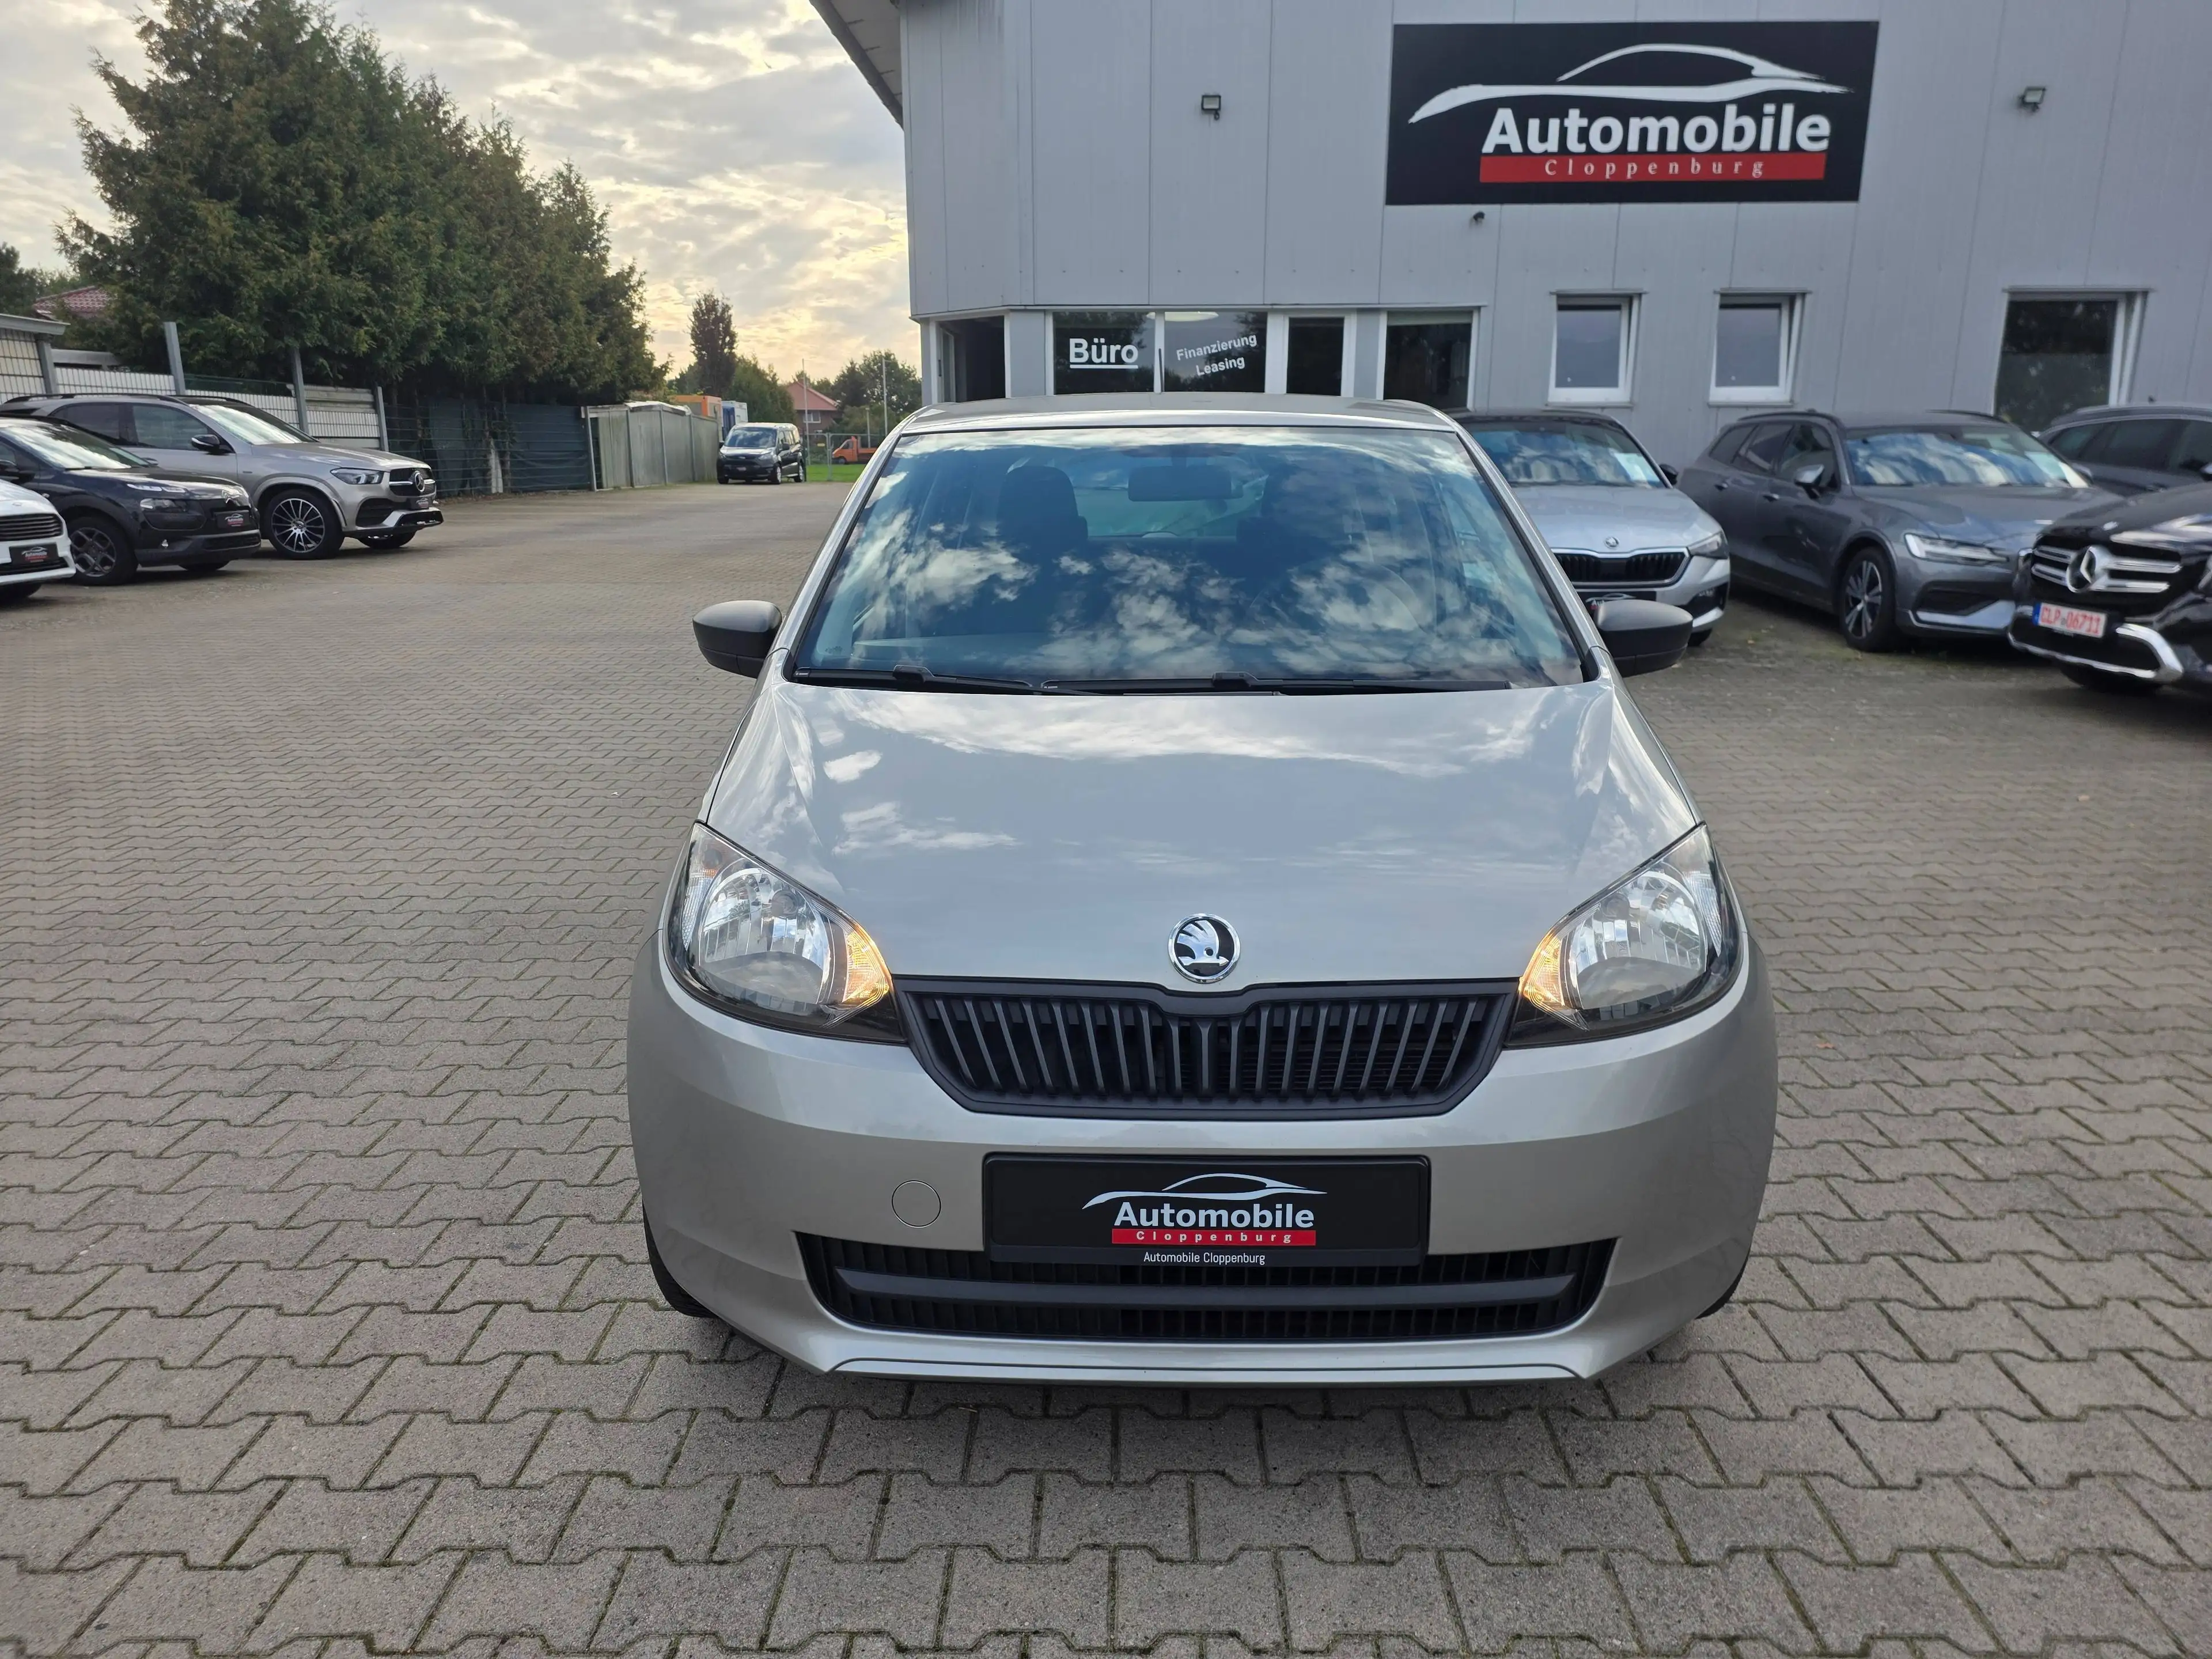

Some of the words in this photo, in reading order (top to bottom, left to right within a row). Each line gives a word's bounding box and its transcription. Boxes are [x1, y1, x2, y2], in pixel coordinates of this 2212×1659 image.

[1482, 103, 1831, 153] Automobile
[1545, 157, 1764, 179] Cloppenburg
[1070, 338, 1138, 363] Büro
[1176, 334, 1257, 361] Finanzierung
[1196, 357, 1245, 376] Leasing
[1114, 1202, 1315, 1228] Automobile
[1137, 1230, 1291, 1244] Cloppenburg
[1143, 1251, 1200, 1263] Automobile
[1203, 1252, 1266, 1266] Cloppenburg
